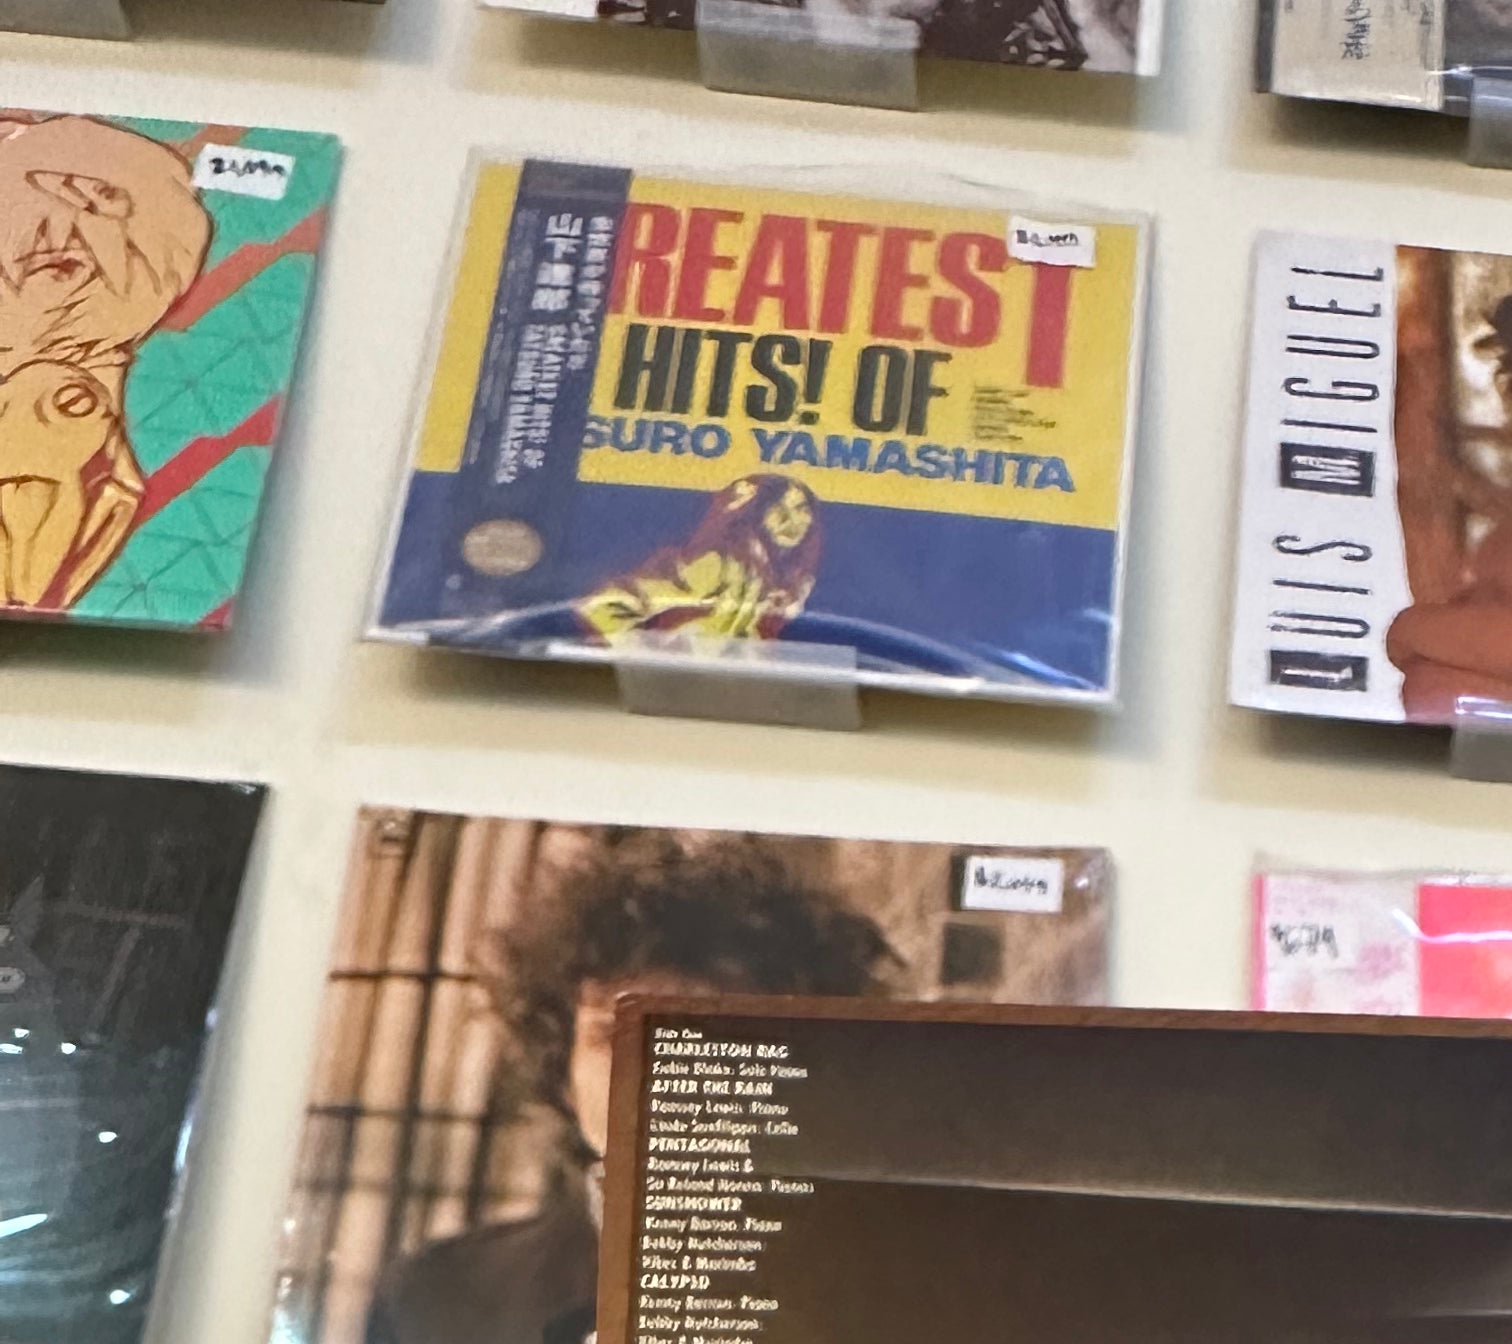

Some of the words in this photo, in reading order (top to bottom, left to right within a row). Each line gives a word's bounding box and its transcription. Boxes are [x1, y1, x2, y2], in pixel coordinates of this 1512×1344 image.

[606, 200, 1077, 389] REATEST
[583, 416, 732, 459] SURO
[751, 426, 1076, 493] YAMASHITA
[612, 323, 832, 426] HITS!
[853, 343, 951, 437] OF
[1280, 265, 1386, 498] MIGUEL
[1266, 533, 1373, 692] LUIS
